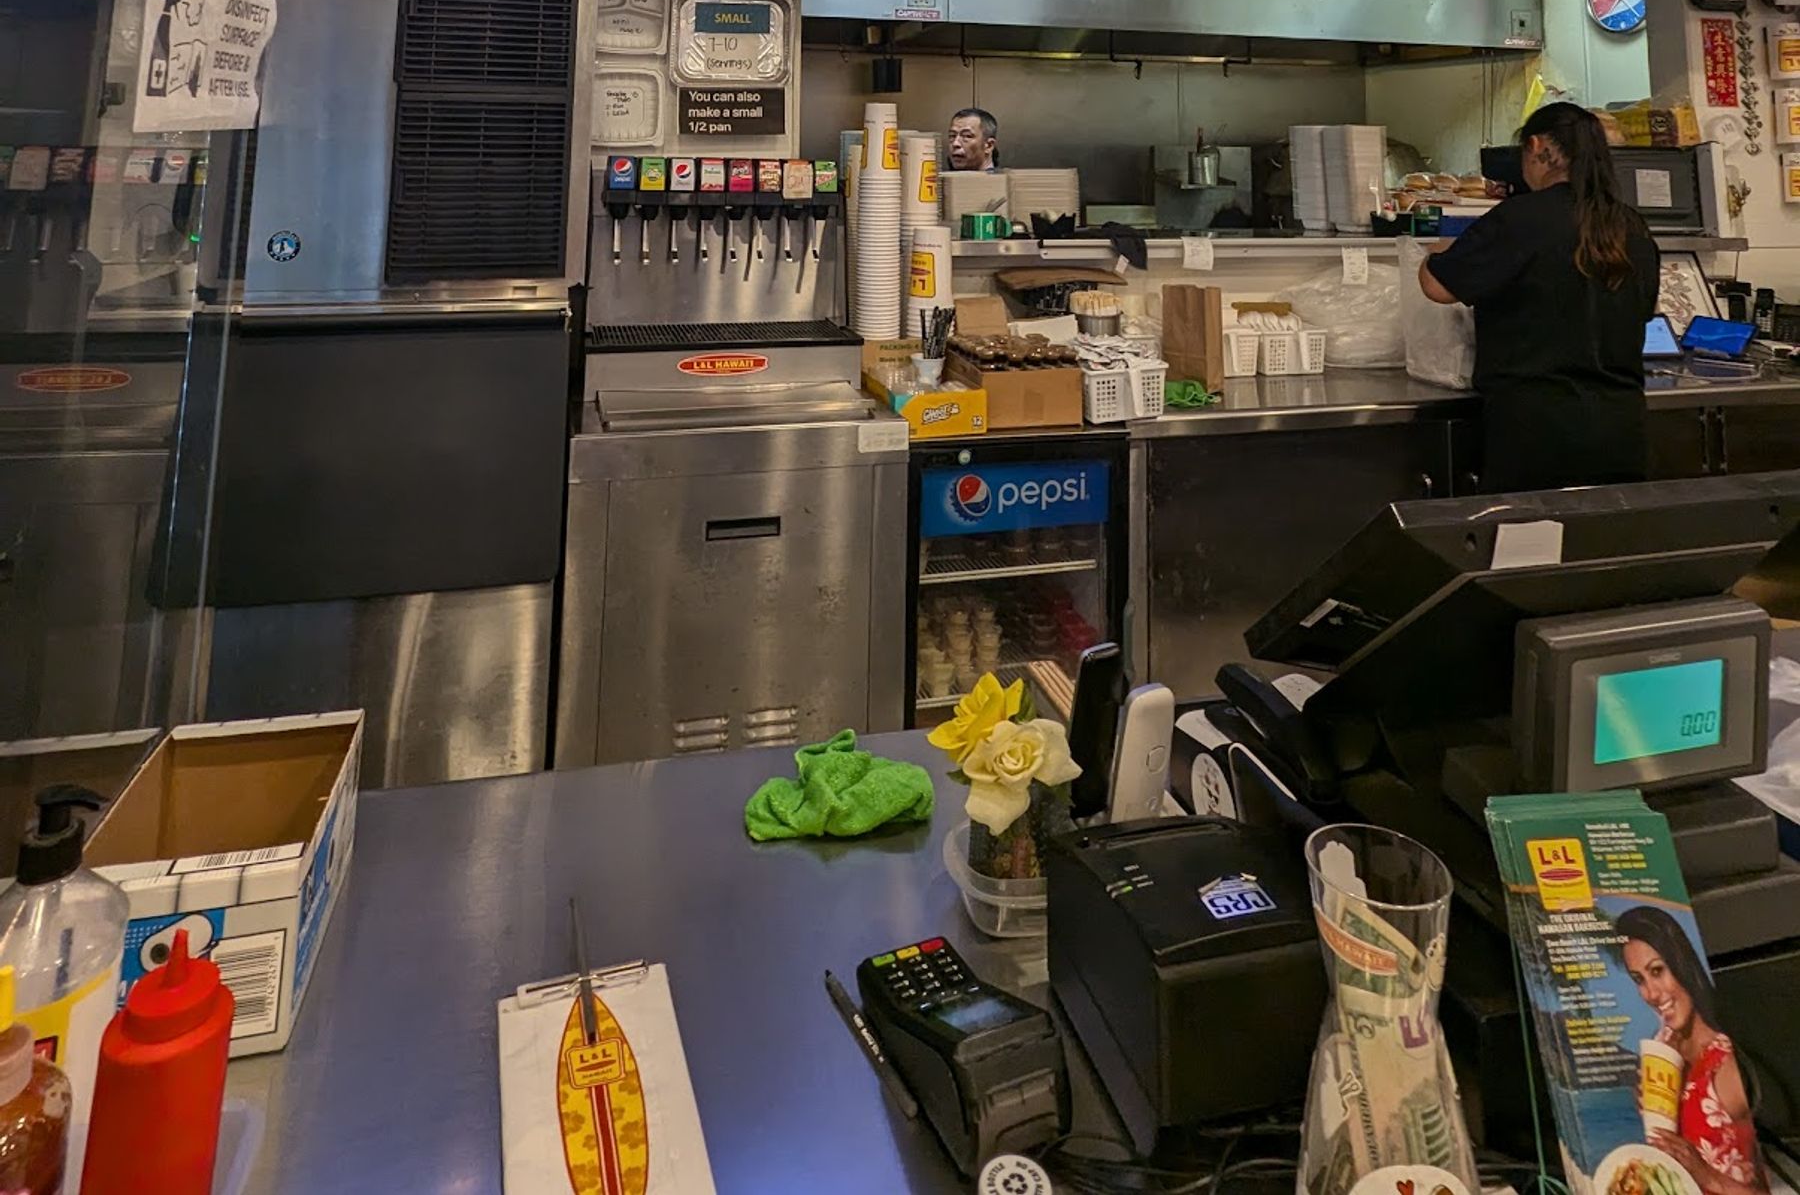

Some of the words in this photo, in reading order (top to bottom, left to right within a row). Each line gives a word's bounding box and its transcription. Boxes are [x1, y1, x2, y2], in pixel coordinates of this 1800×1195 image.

[714, 13, 752, 24] SMALL
[220, 24, 261, 47] SURFACE
[708, 37, 738, 51] 7-10
[213, 50, 244, 71] BEFORE
[208, 78, 234, 97] AFTER
[688, 91, 711, 102] You
[714, 93, 735, 102] can
[737, 91, 761, 102] also
[688, 107, 720, 117] make
[723, 109, 730, 117] a
[732, 107, 763, 117] small
[688, 121, 707, 132] 1/2
[709, 123, 732, 134] pan
[693, 361, 714, 369] L&L
[998, 472, 1086, 513] pepsi
[1680, 709, 1716, 737] 0.00
[1538, 846, 1576, 866] L&L
[1565, 912, 1598, 923] ORIGINAL
[1538, 924, 1574, 935] HAWAIIAN
[580, 1048, 612, 1063] L&L
[1646, 1065, 1676, 1092] L&L
